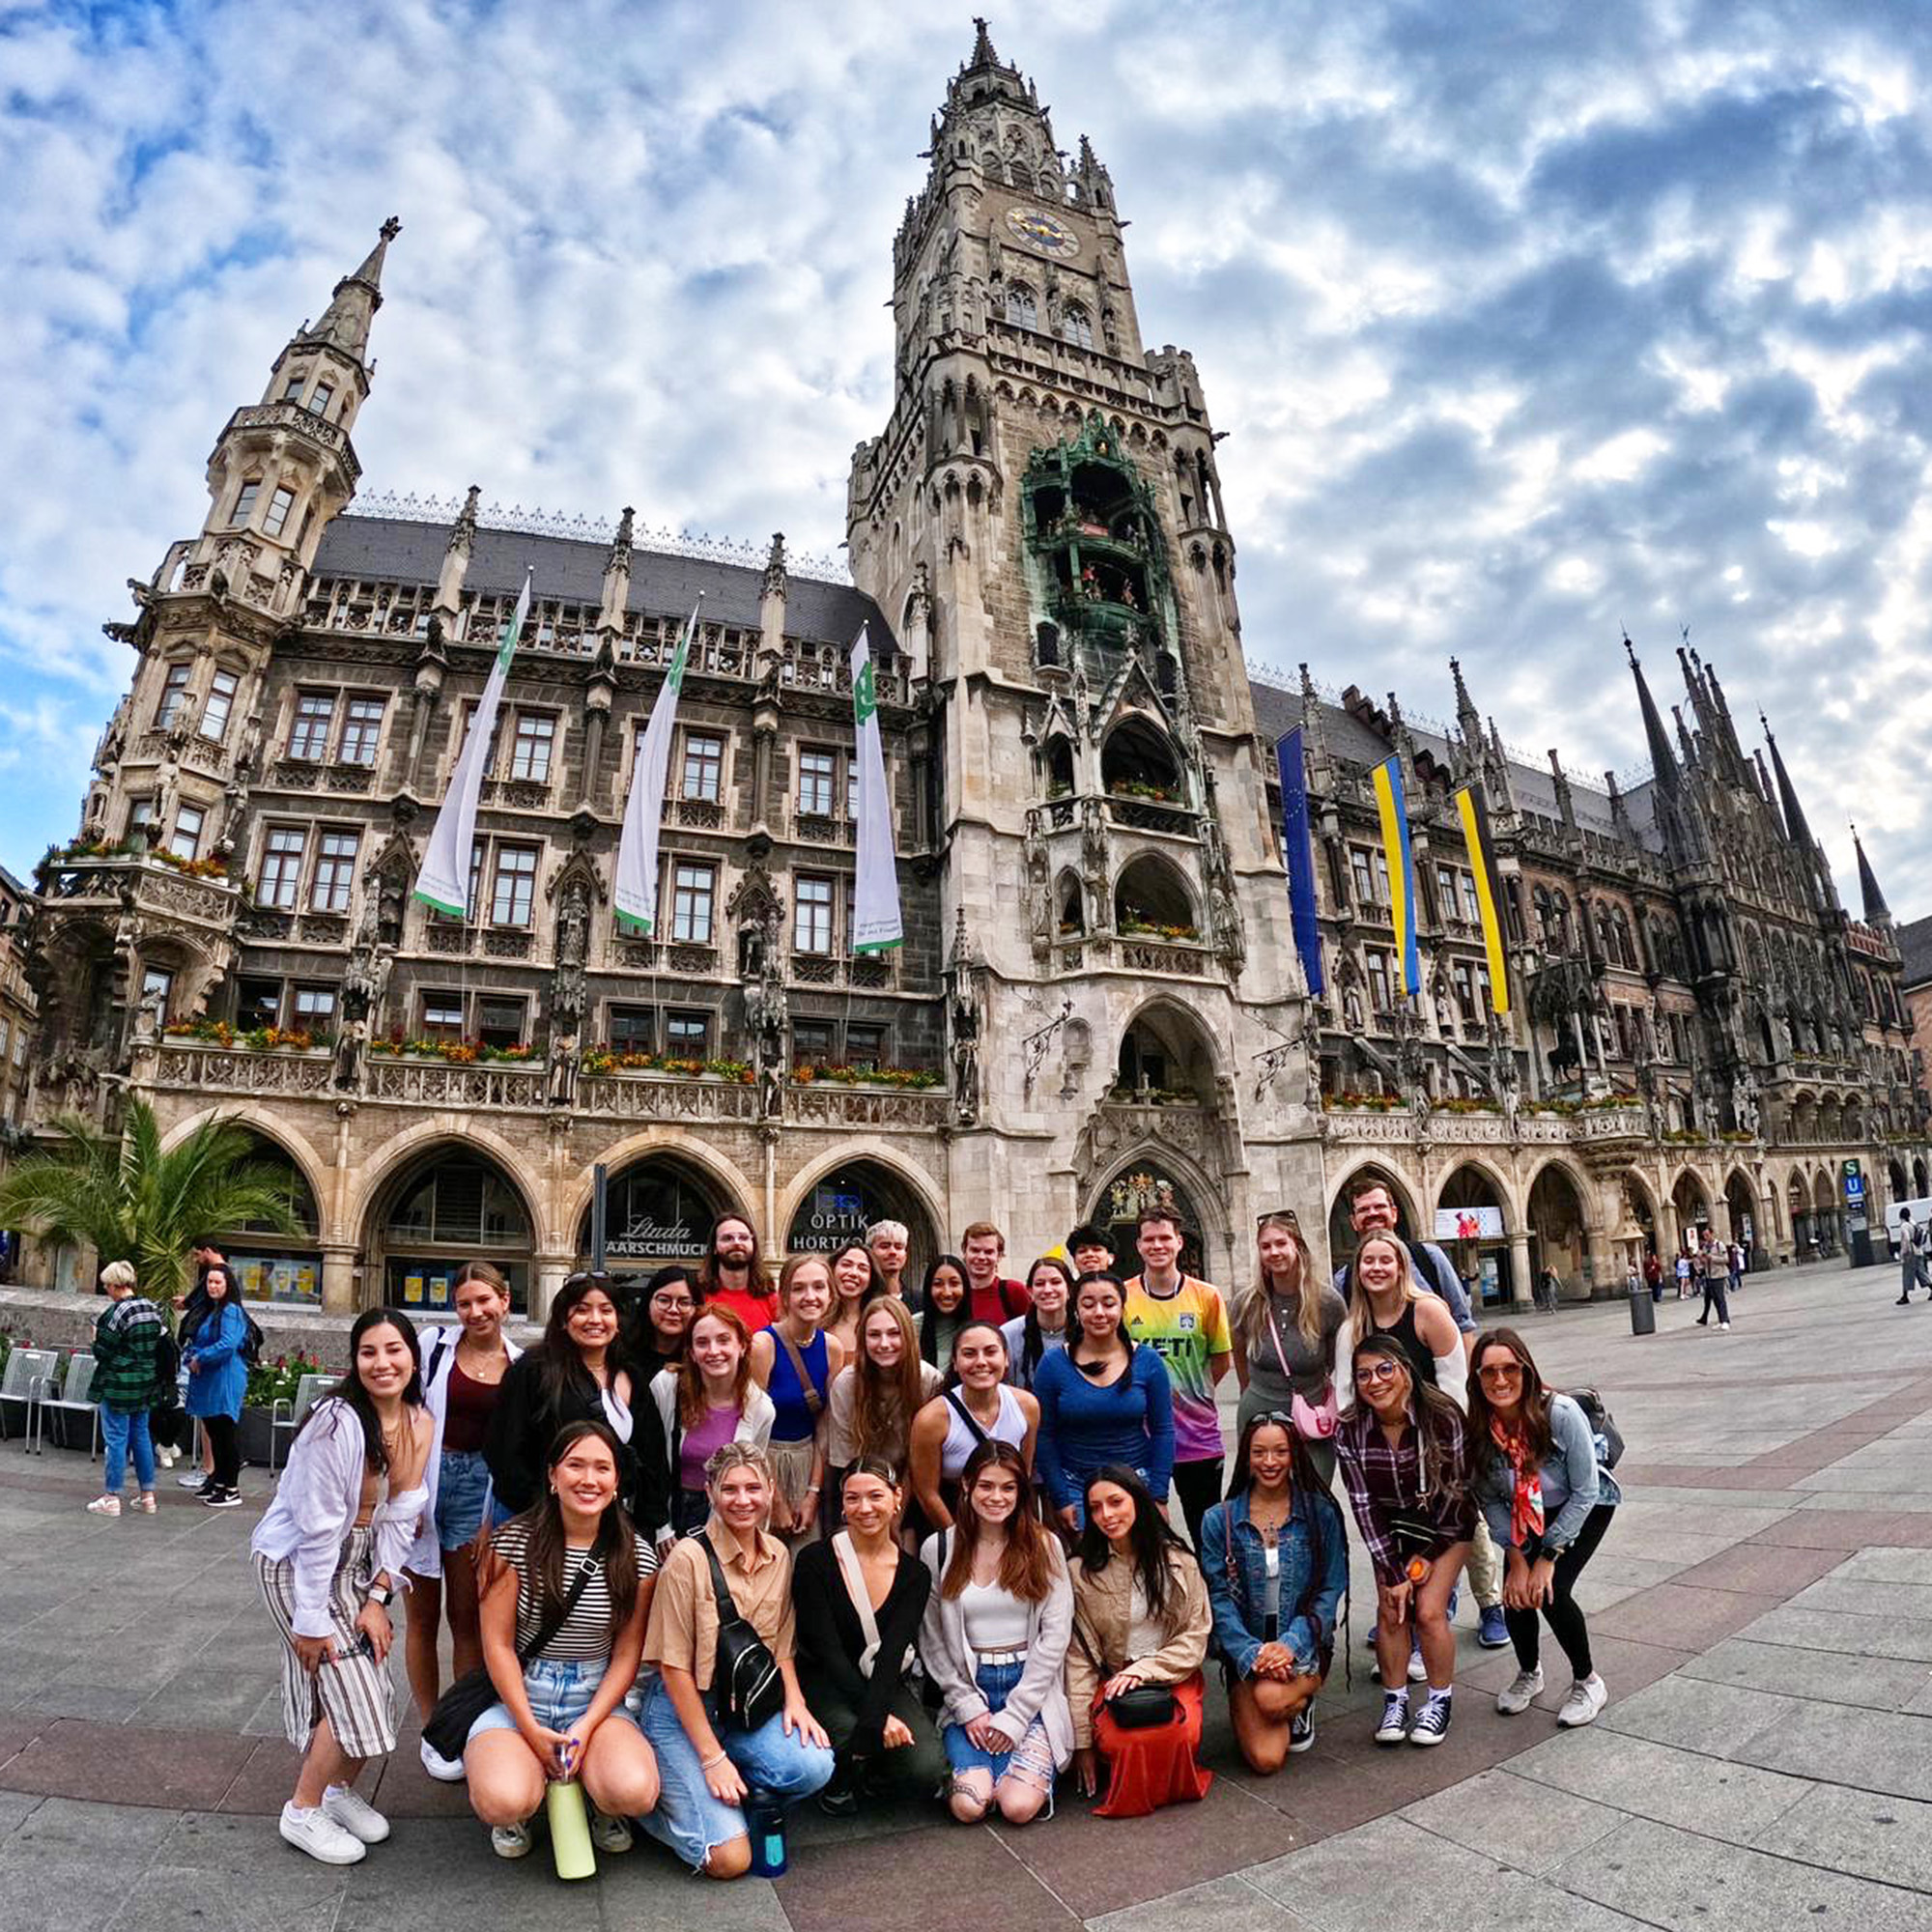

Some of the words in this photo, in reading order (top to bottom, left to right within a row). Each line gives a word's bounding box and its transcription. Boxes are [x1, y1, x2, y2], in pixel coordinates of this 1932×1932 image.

[1845, 1161, 1857, 1176] S
[1847, 1178, 1859, 1192] U
[619, 1214, 694, 1239] Linda
[810, 1214, 868, 1231] OPTIK
[605, 1240, 708, 1256] AARSCHMUCK
